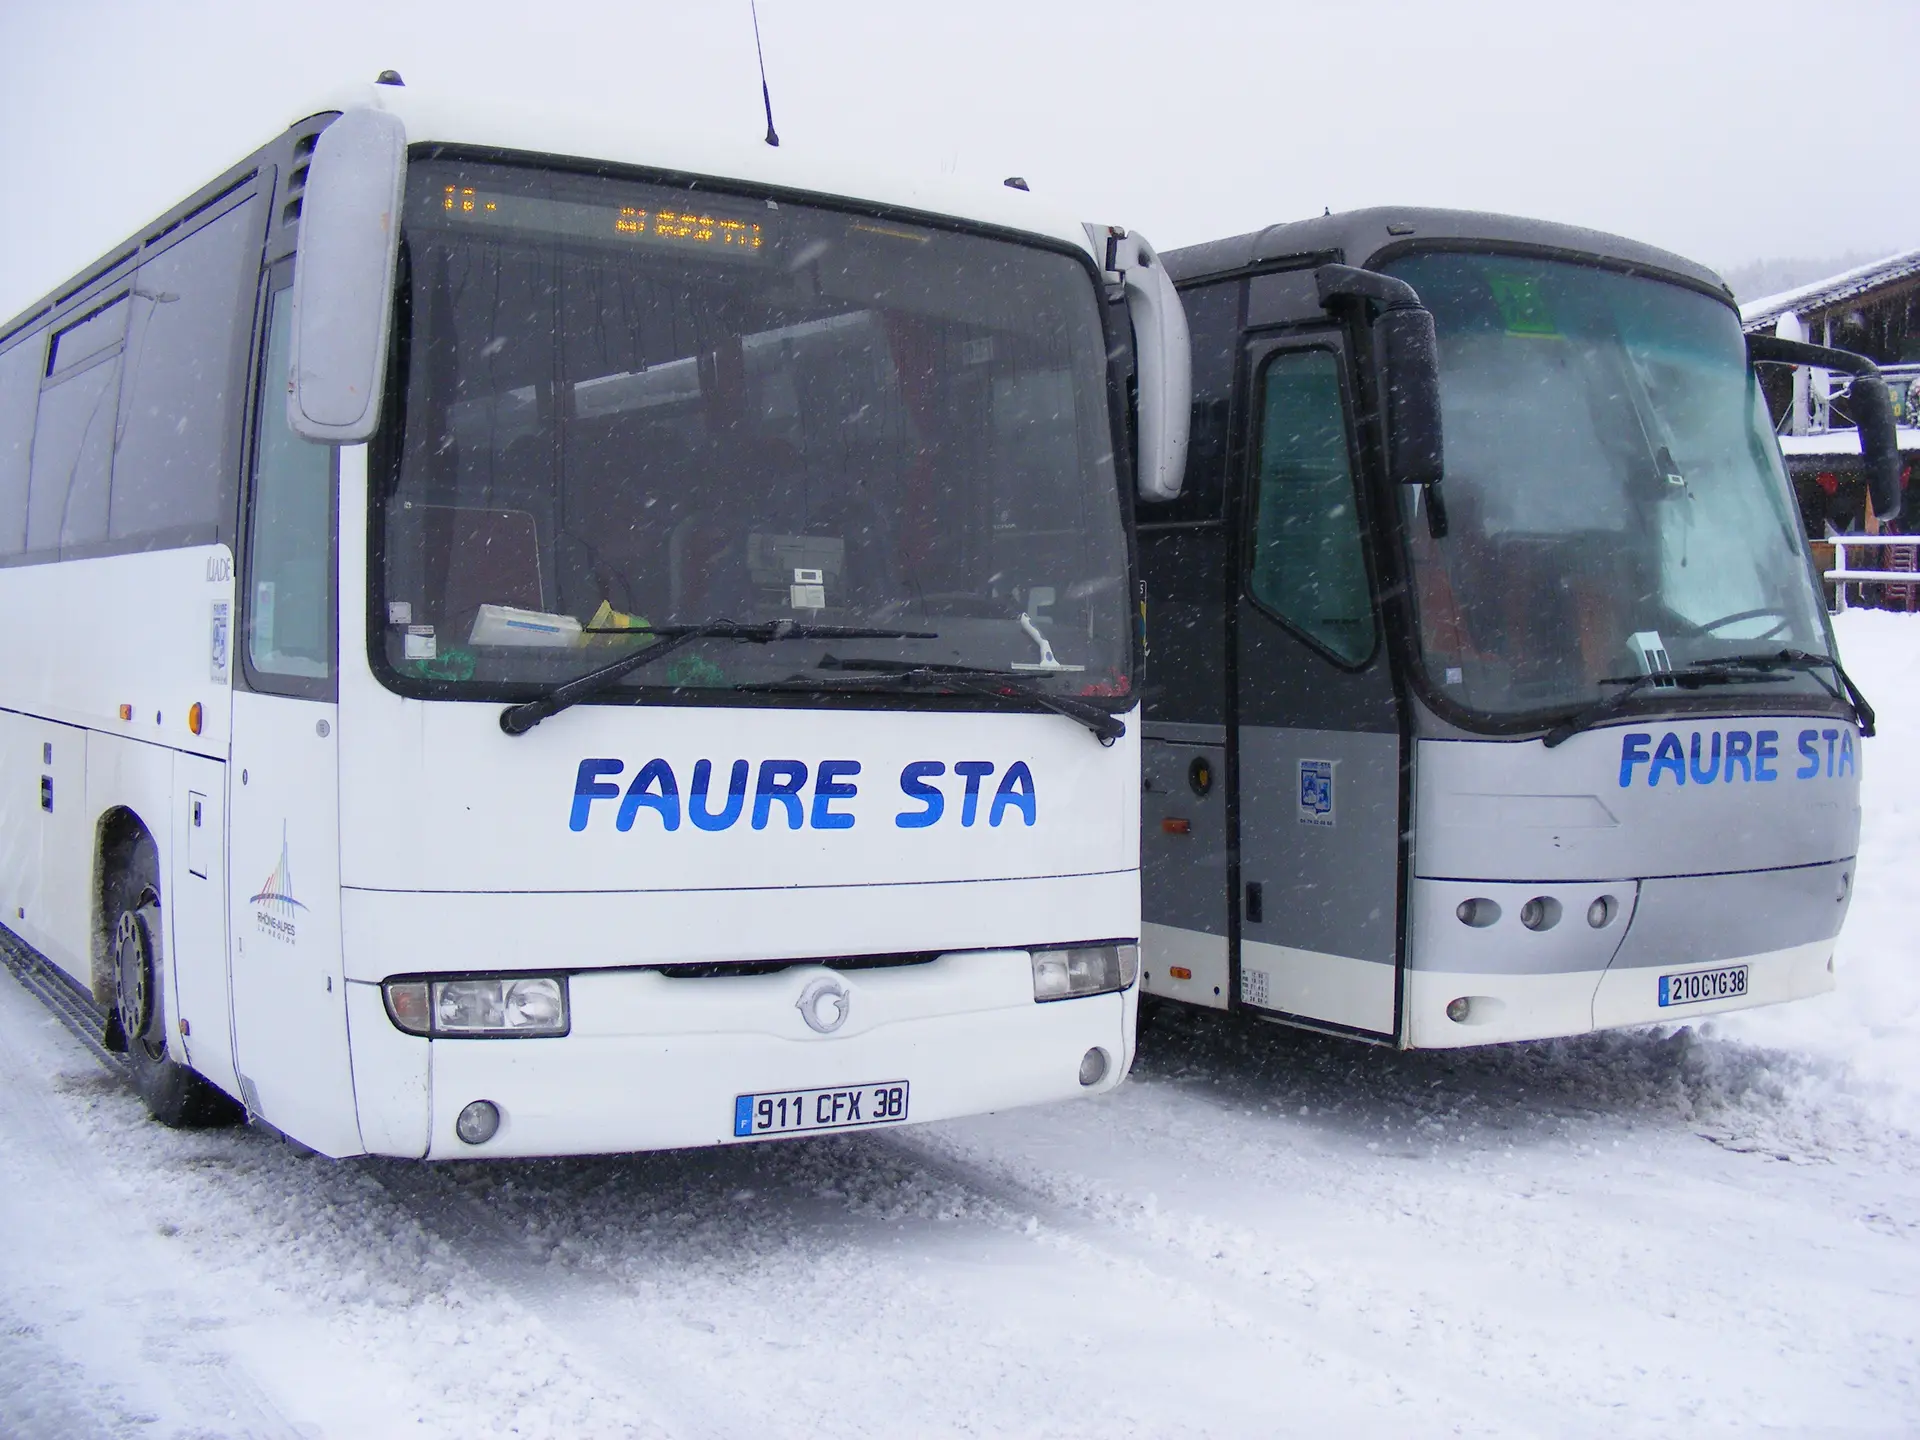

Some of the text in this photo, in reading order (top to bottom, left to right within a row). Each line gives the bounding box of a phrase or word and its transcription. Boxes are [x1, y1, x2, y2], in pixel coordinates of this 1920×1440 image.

[1619, 728, 1855, 788] FAURE STA
[569, 757, 1037, 832] FAURE STA
[740, 1119, 748, 1129] F
[757, 1087, 903, 1129] 911 CFX 38
